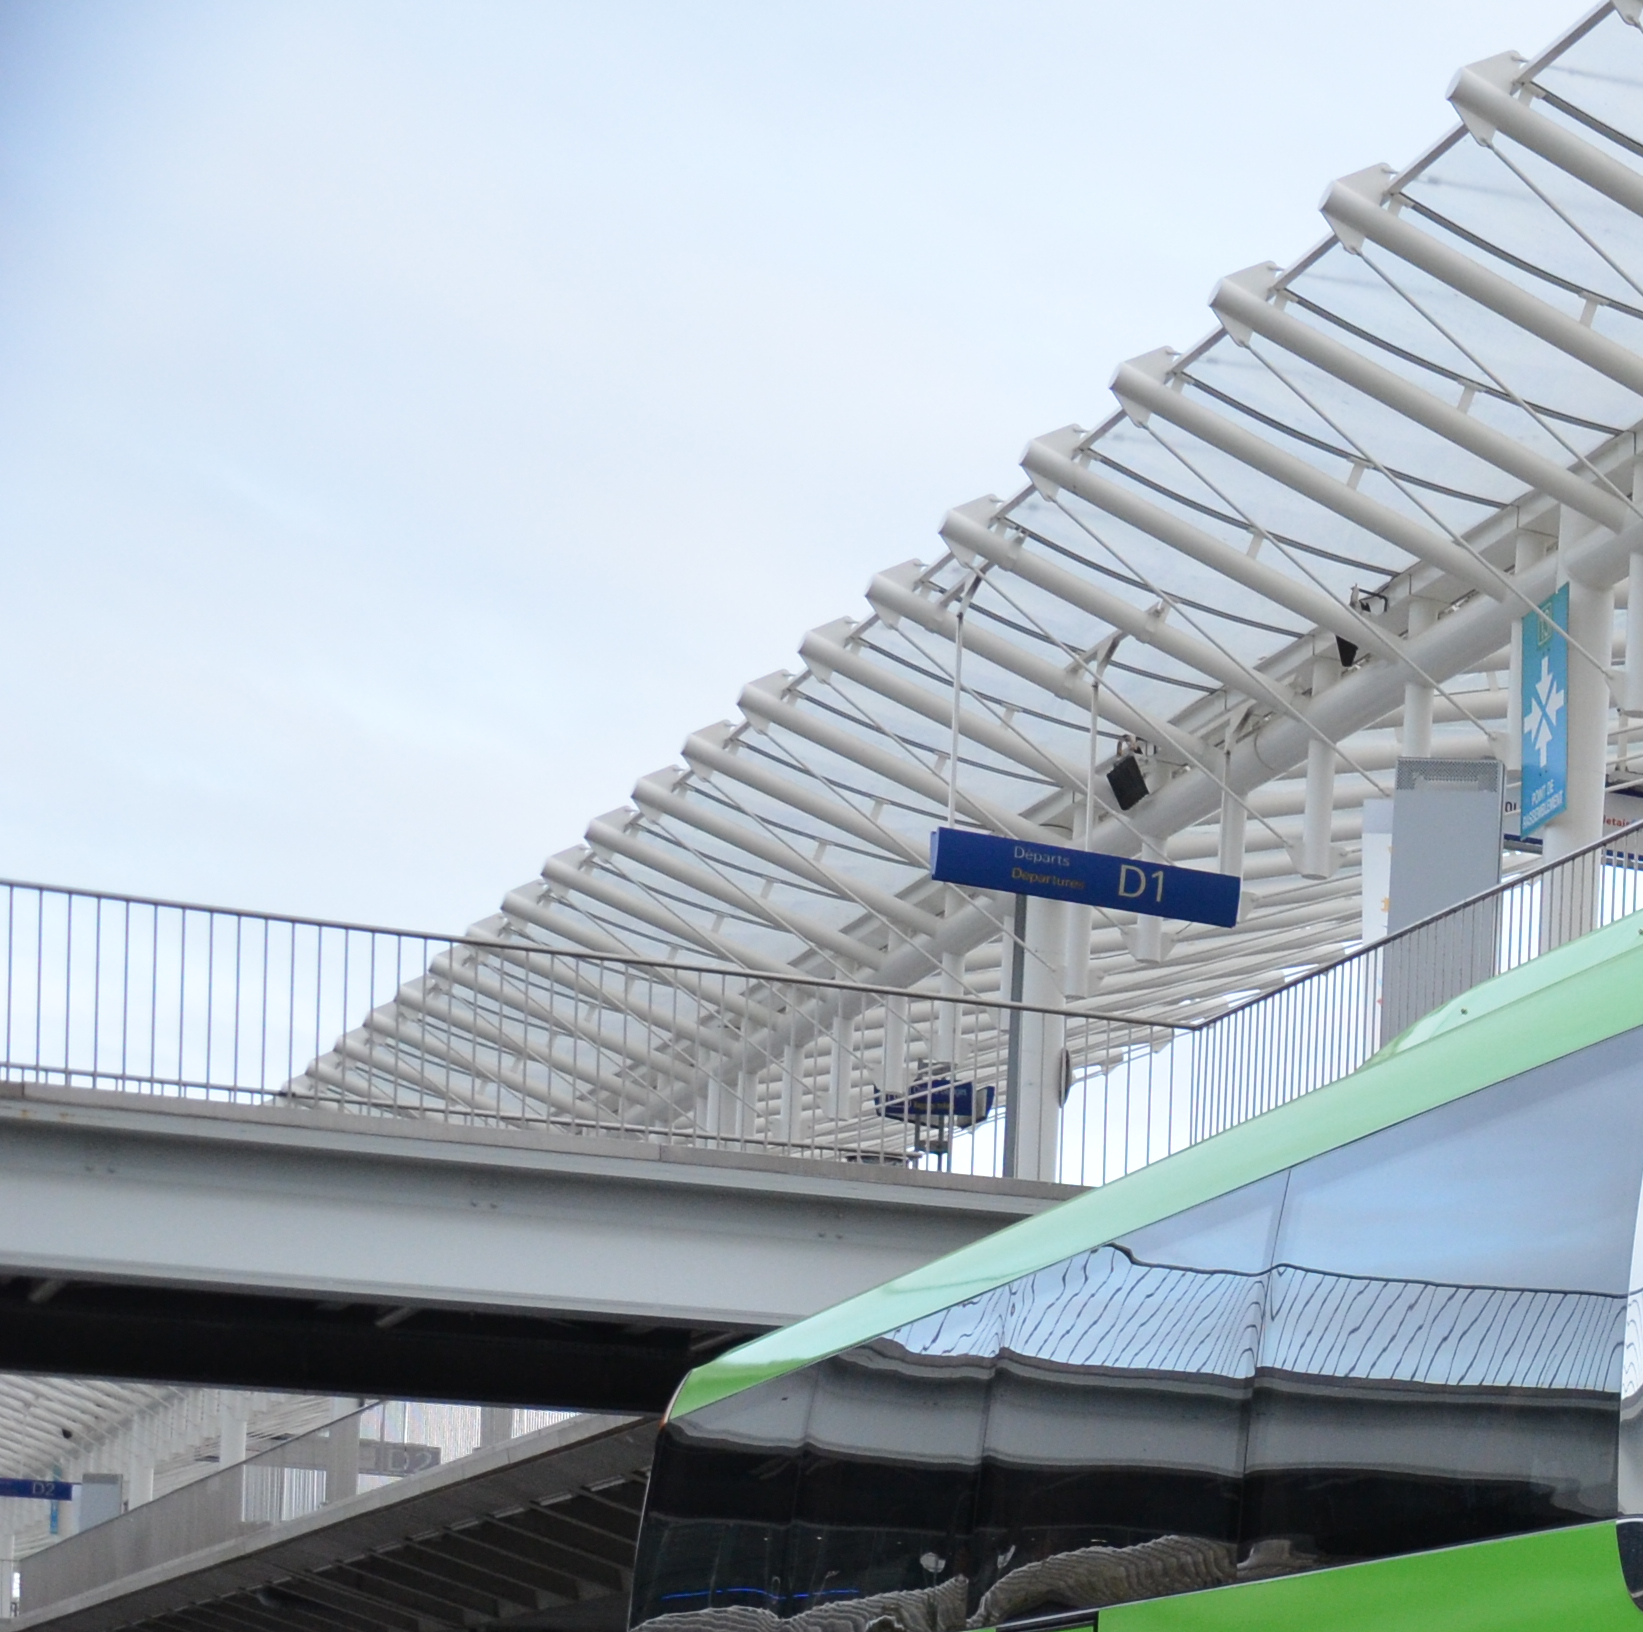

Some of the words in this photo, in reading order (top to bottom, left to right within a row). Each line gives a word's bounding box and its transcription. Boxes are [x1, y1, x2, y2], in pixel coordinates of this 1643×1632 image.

[1011, 866, 1086, 892] Departures
[1013, 845, 1071, 868] Départs
[1117, 864, 1164, 903] D1
[32, 1481, 55, 1497] D2
